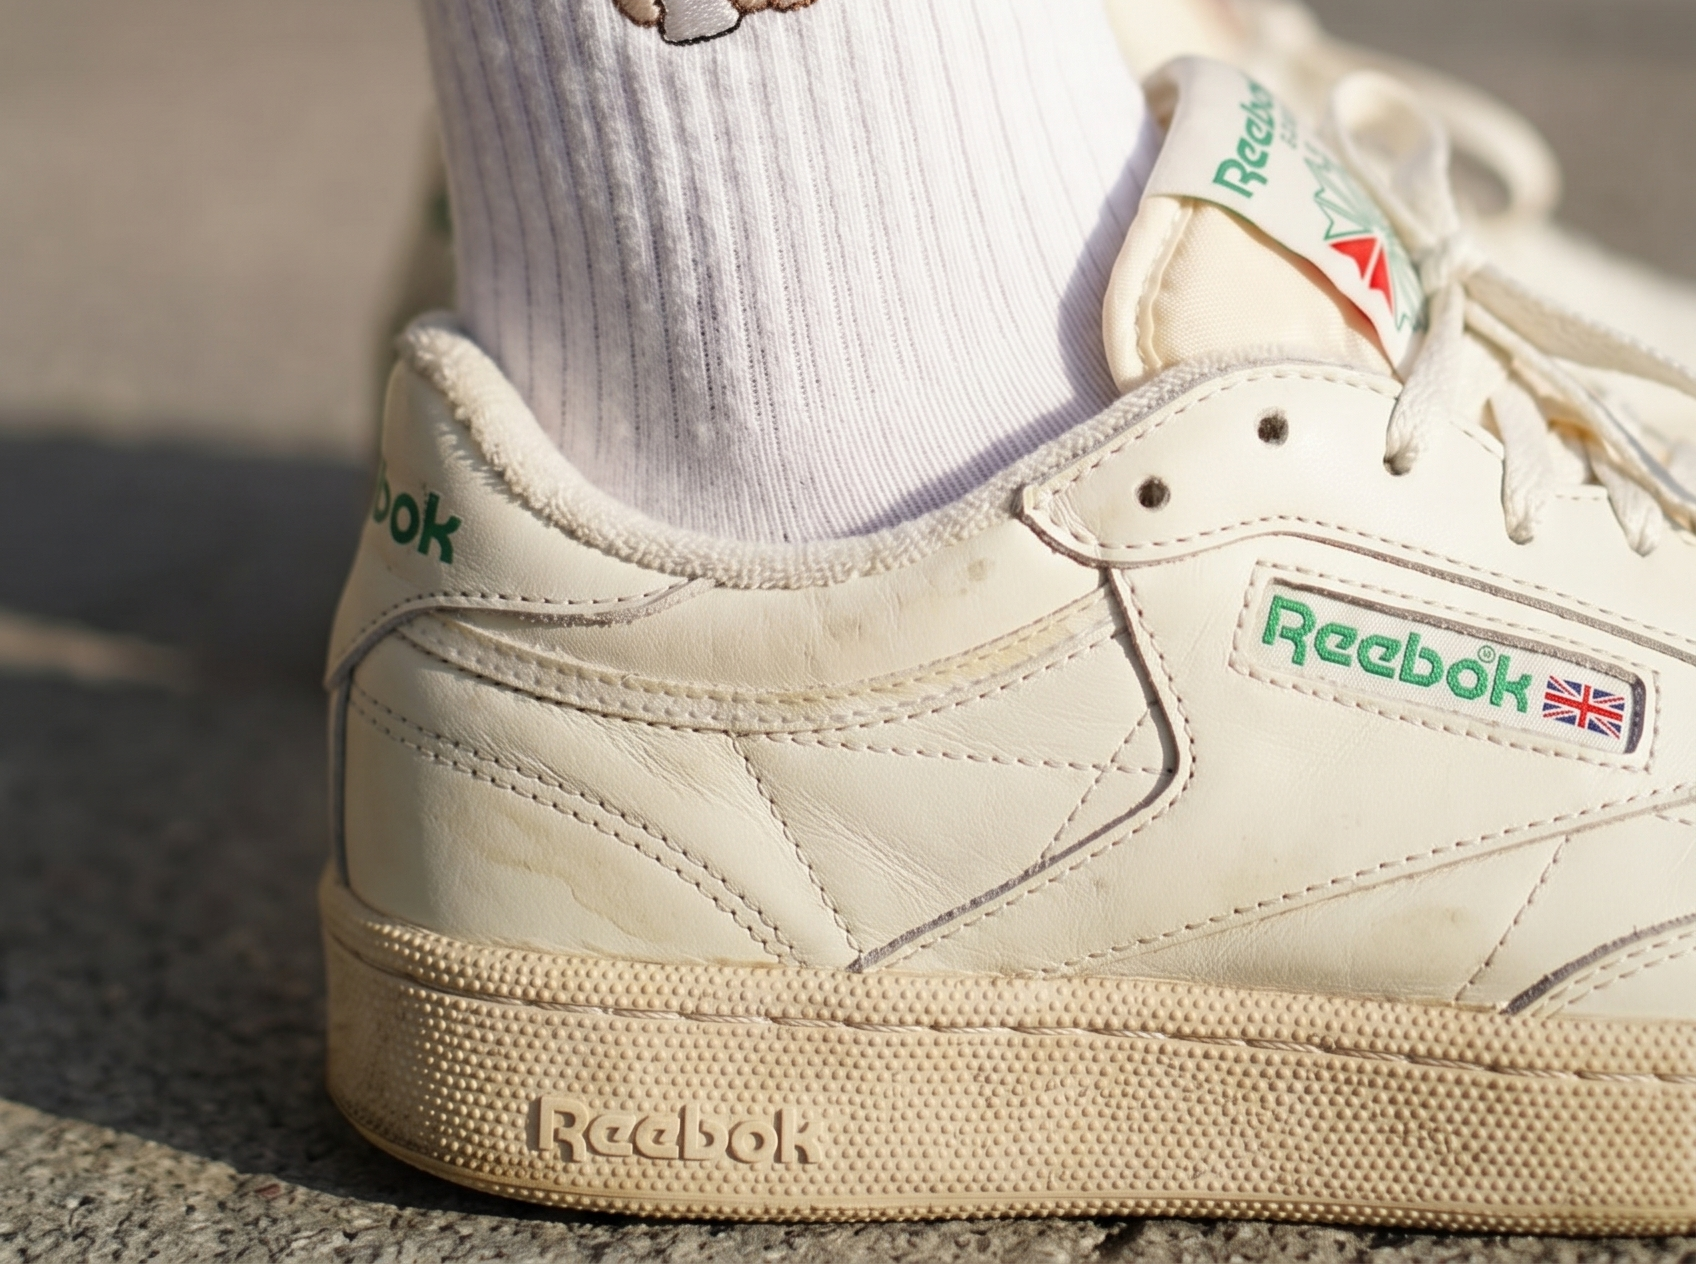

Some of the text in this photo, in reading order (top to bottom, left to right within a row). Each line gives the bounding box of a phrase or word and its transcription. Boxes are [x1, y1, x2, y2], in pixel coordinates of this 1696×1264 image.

[1212, 75, 1275, 199] Reebo
[1261, 594, 1533, 714] Reebok
[536, 1094, 824, 1164] Reebok
